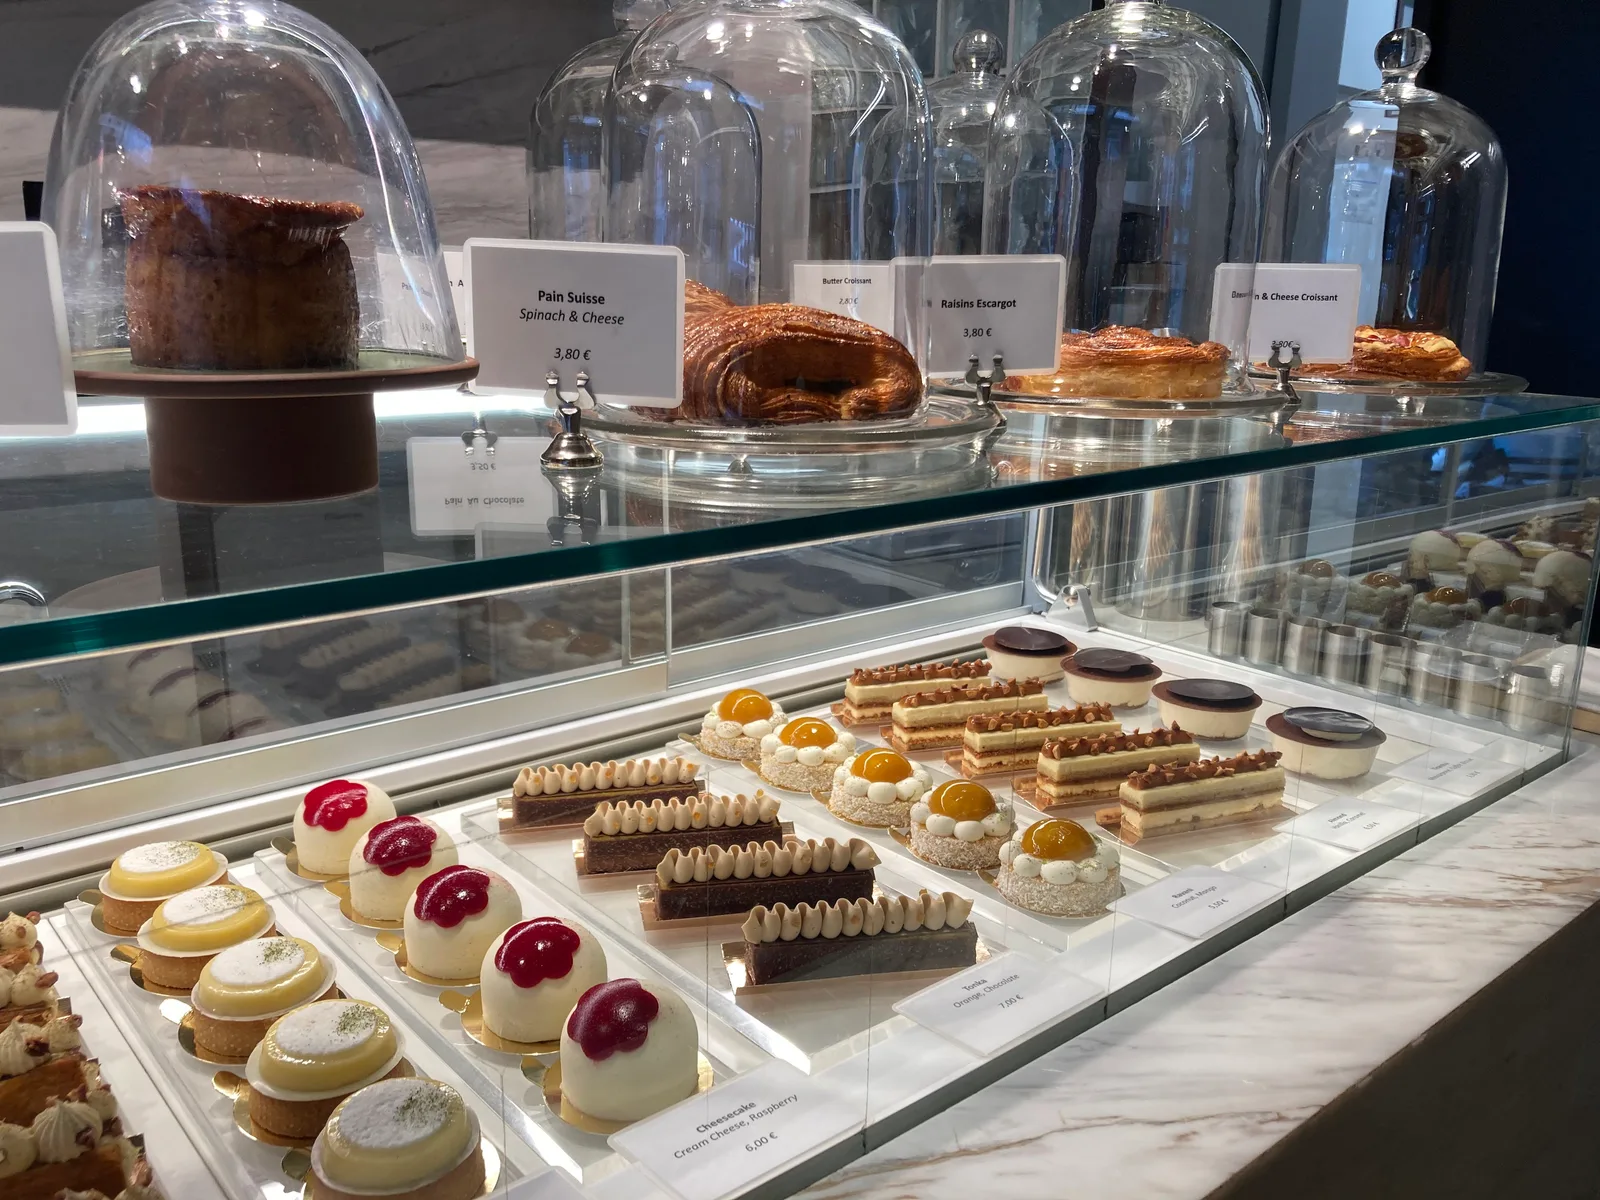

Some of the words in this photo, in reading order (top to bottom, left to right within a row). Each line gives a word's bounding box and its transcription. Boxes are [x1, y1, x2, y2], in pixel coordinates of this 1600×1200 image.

[822, 277, 843, 285] Butter
[844, 277, 872, 285] Croissant
[538, 290, 563, 303] Pain
[567, 292, 605, 304] Suisse
[1261, 292, 1268, 300] &
[1270, 292, 1299, 301] Cheese
[1301, 293, 1338, 302] Croissant
[941, 299, 974, 308] Raisins
[977, 299, 1017, 310] Escargot
[519, 308, 565, 322] Spinach
[569, 310, 578, 322] &
[582, 311, 625, 325] Cheese
[963, 328, 983, 338] 3,80
[984, 328, 992, 337] €
[554, 347, 580, 361] 3,80
[582, 349, 591, 361] €
[953, 991, 985, 1009] Orange,
[985, 973, 1020, 993] Chocolate
[962, 978, 988, 992] Tonka
[998, 997, 1017, 1010] 7,00
[1016, 994, 1024, 1002] €
[696, 1100, 757, 1134] Cheesecake
[674, 1137, 709, 1159] Cream
[710, 1117, 750, 1143] Cheese,
[749, 1093, 799, 1123] Raspberry
[745, 1136, 769, 1153] 6,00
[769, 1131, 779, 1141] €
